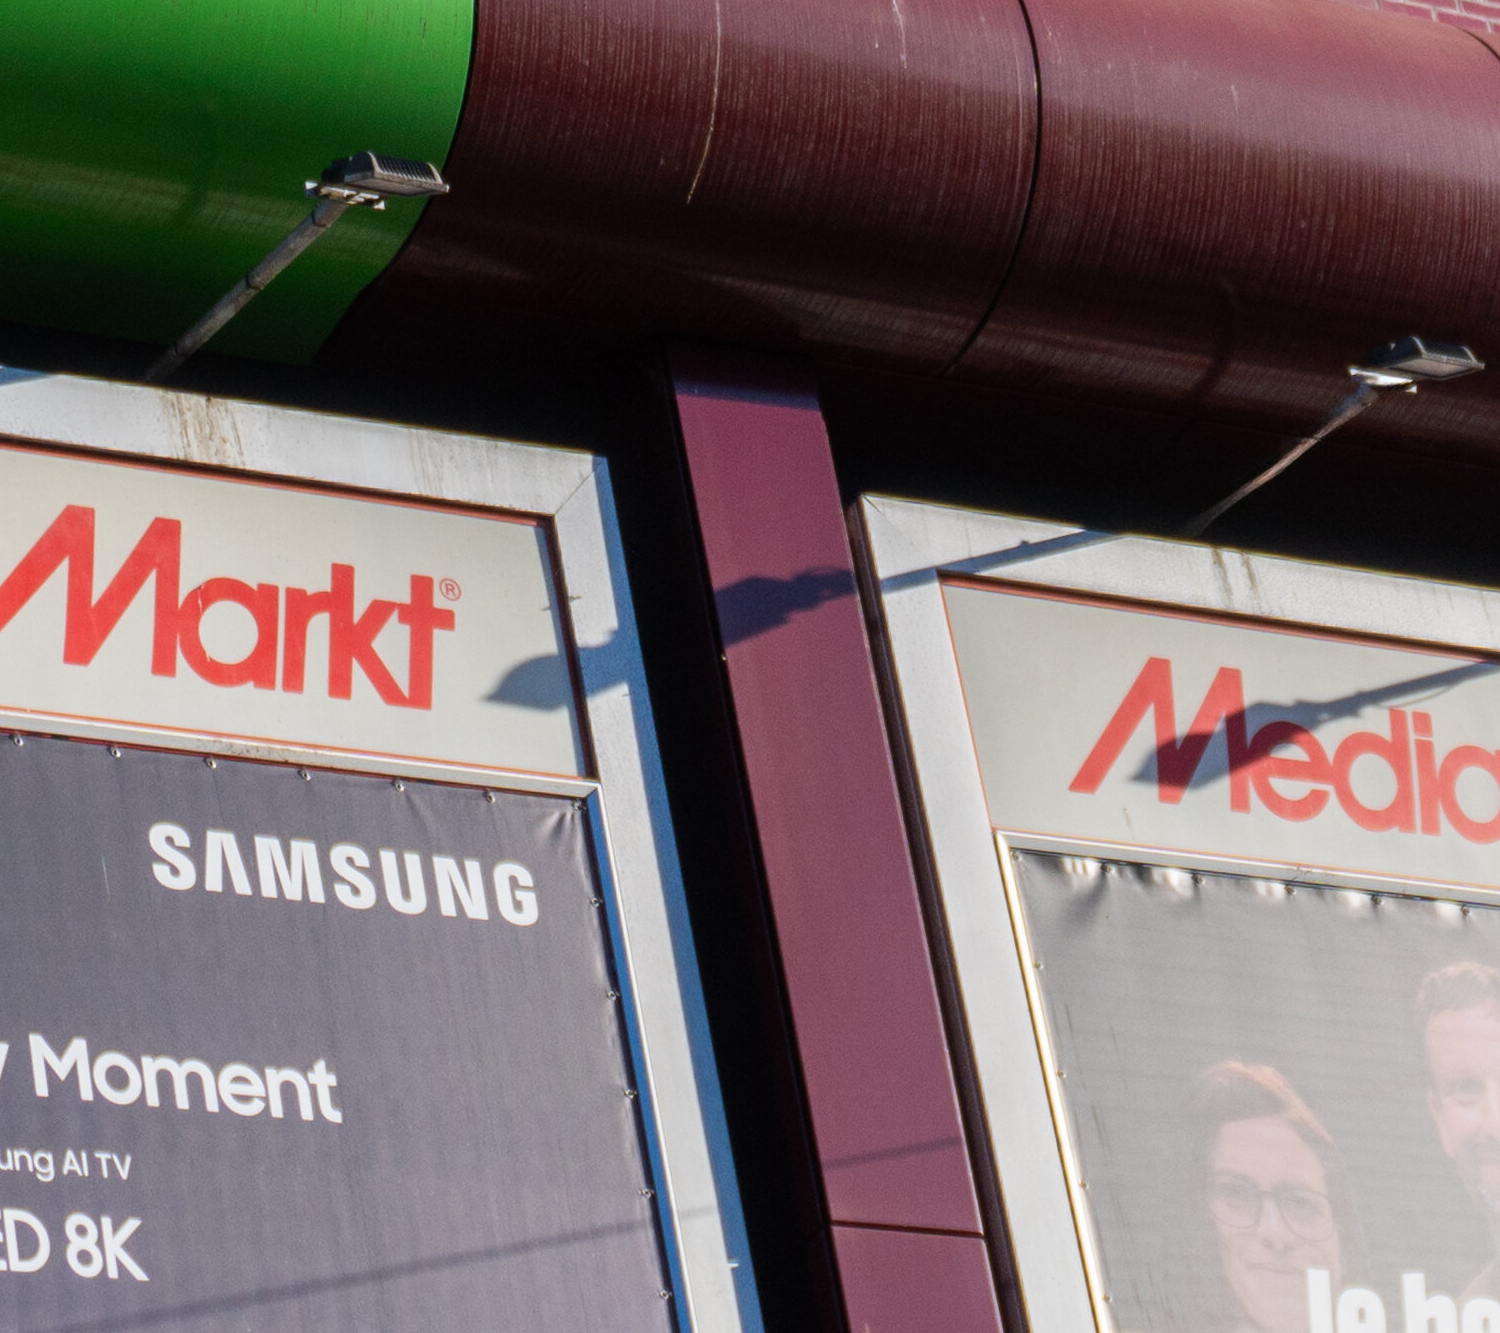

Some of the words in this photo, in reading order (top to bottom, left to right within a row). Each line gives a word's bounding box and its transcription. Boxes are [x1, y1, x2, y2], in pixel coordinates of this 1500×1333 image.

[148, 821, 541, 928] SAMSUNG
[28, 1031, 344, 1125] Moment
[61, 1148, 90, 1177] AI
[93, 1150, 133, 1181] TV
[64, 1211, 151, 1282] 8K
